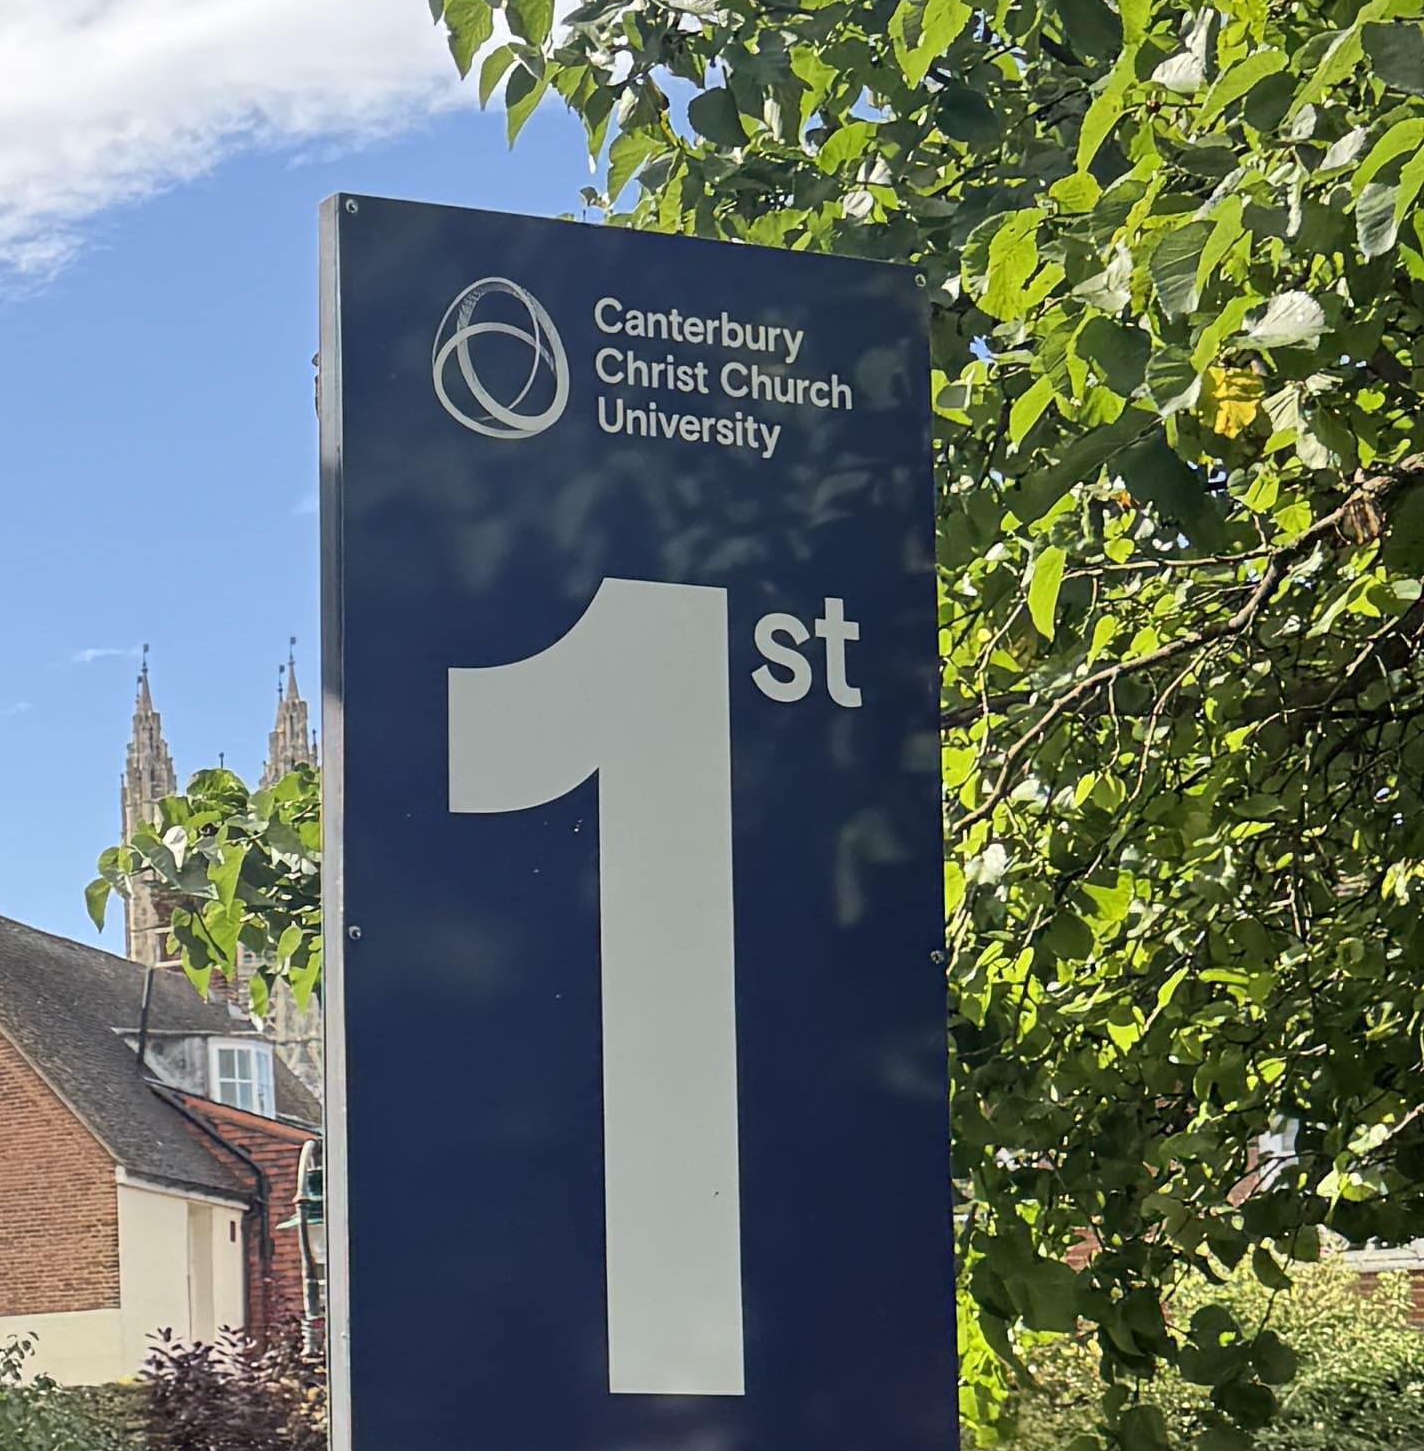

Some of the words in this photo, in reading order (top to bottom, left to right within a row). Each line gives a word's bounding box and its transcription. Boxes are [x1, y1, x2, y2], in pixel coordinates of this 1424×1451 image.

[594, 297, 804, 364] Canterbury
[595, 347, 709, 394] Christ
[720, 361, 853, 410] Church
[598, 396, 781, 459] University
